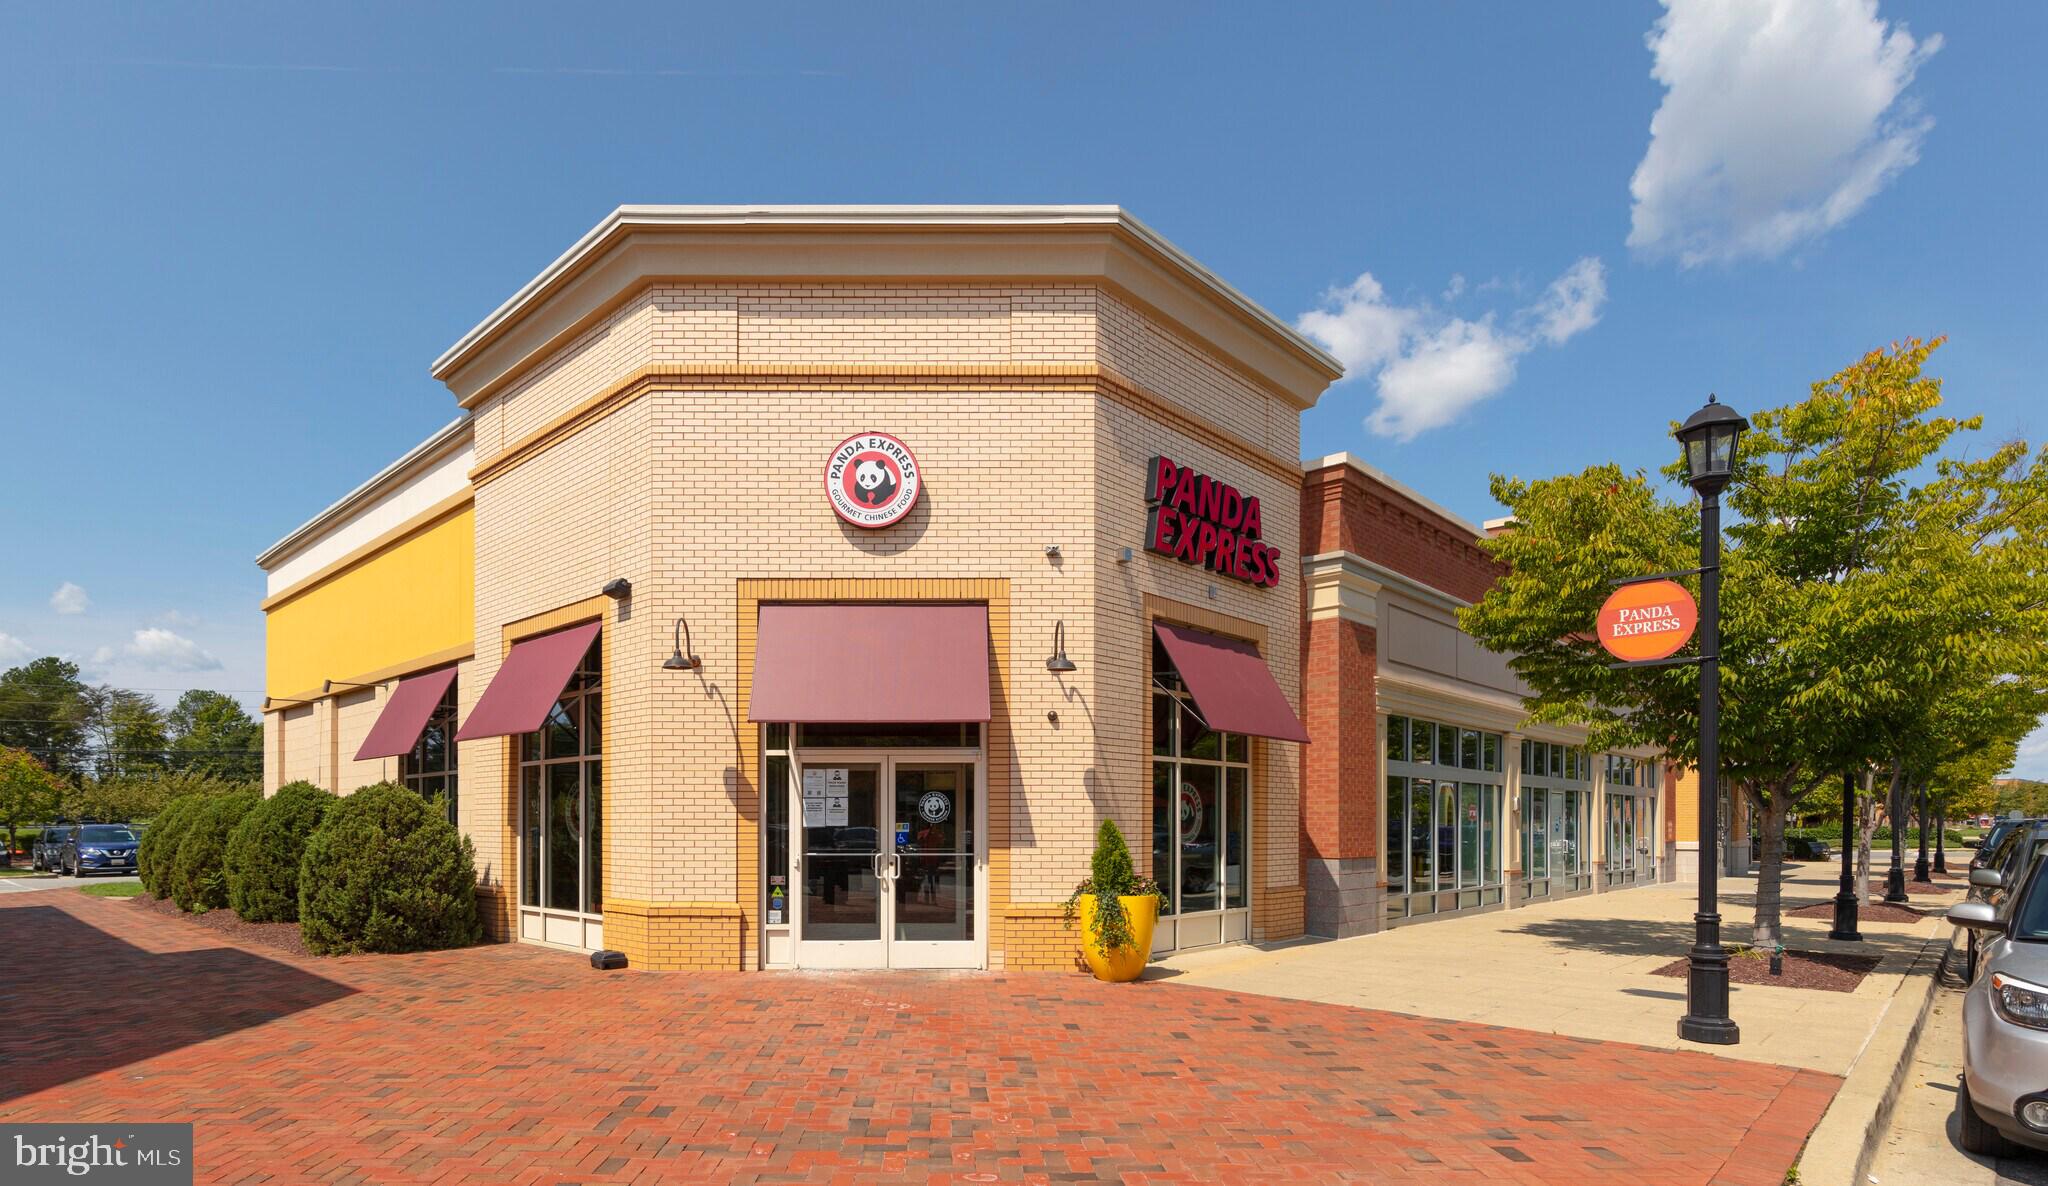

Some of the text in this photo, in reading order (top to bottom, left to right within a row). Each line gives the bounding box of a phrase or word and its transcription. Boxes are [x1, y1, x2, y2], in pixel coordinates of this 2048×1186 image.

[830, 438, 915, 479] PANDA EXPRESS
[831, 488, 913, 521] GOURMET CHINESE FOOD
[1153, 455, 1262, 540] PANDA
[1153, 504, 1281, 588] EXPRESS
[1613, 617, 1681, 637] EXPRESS
[1619, 605, 1673, 623] PANDA
